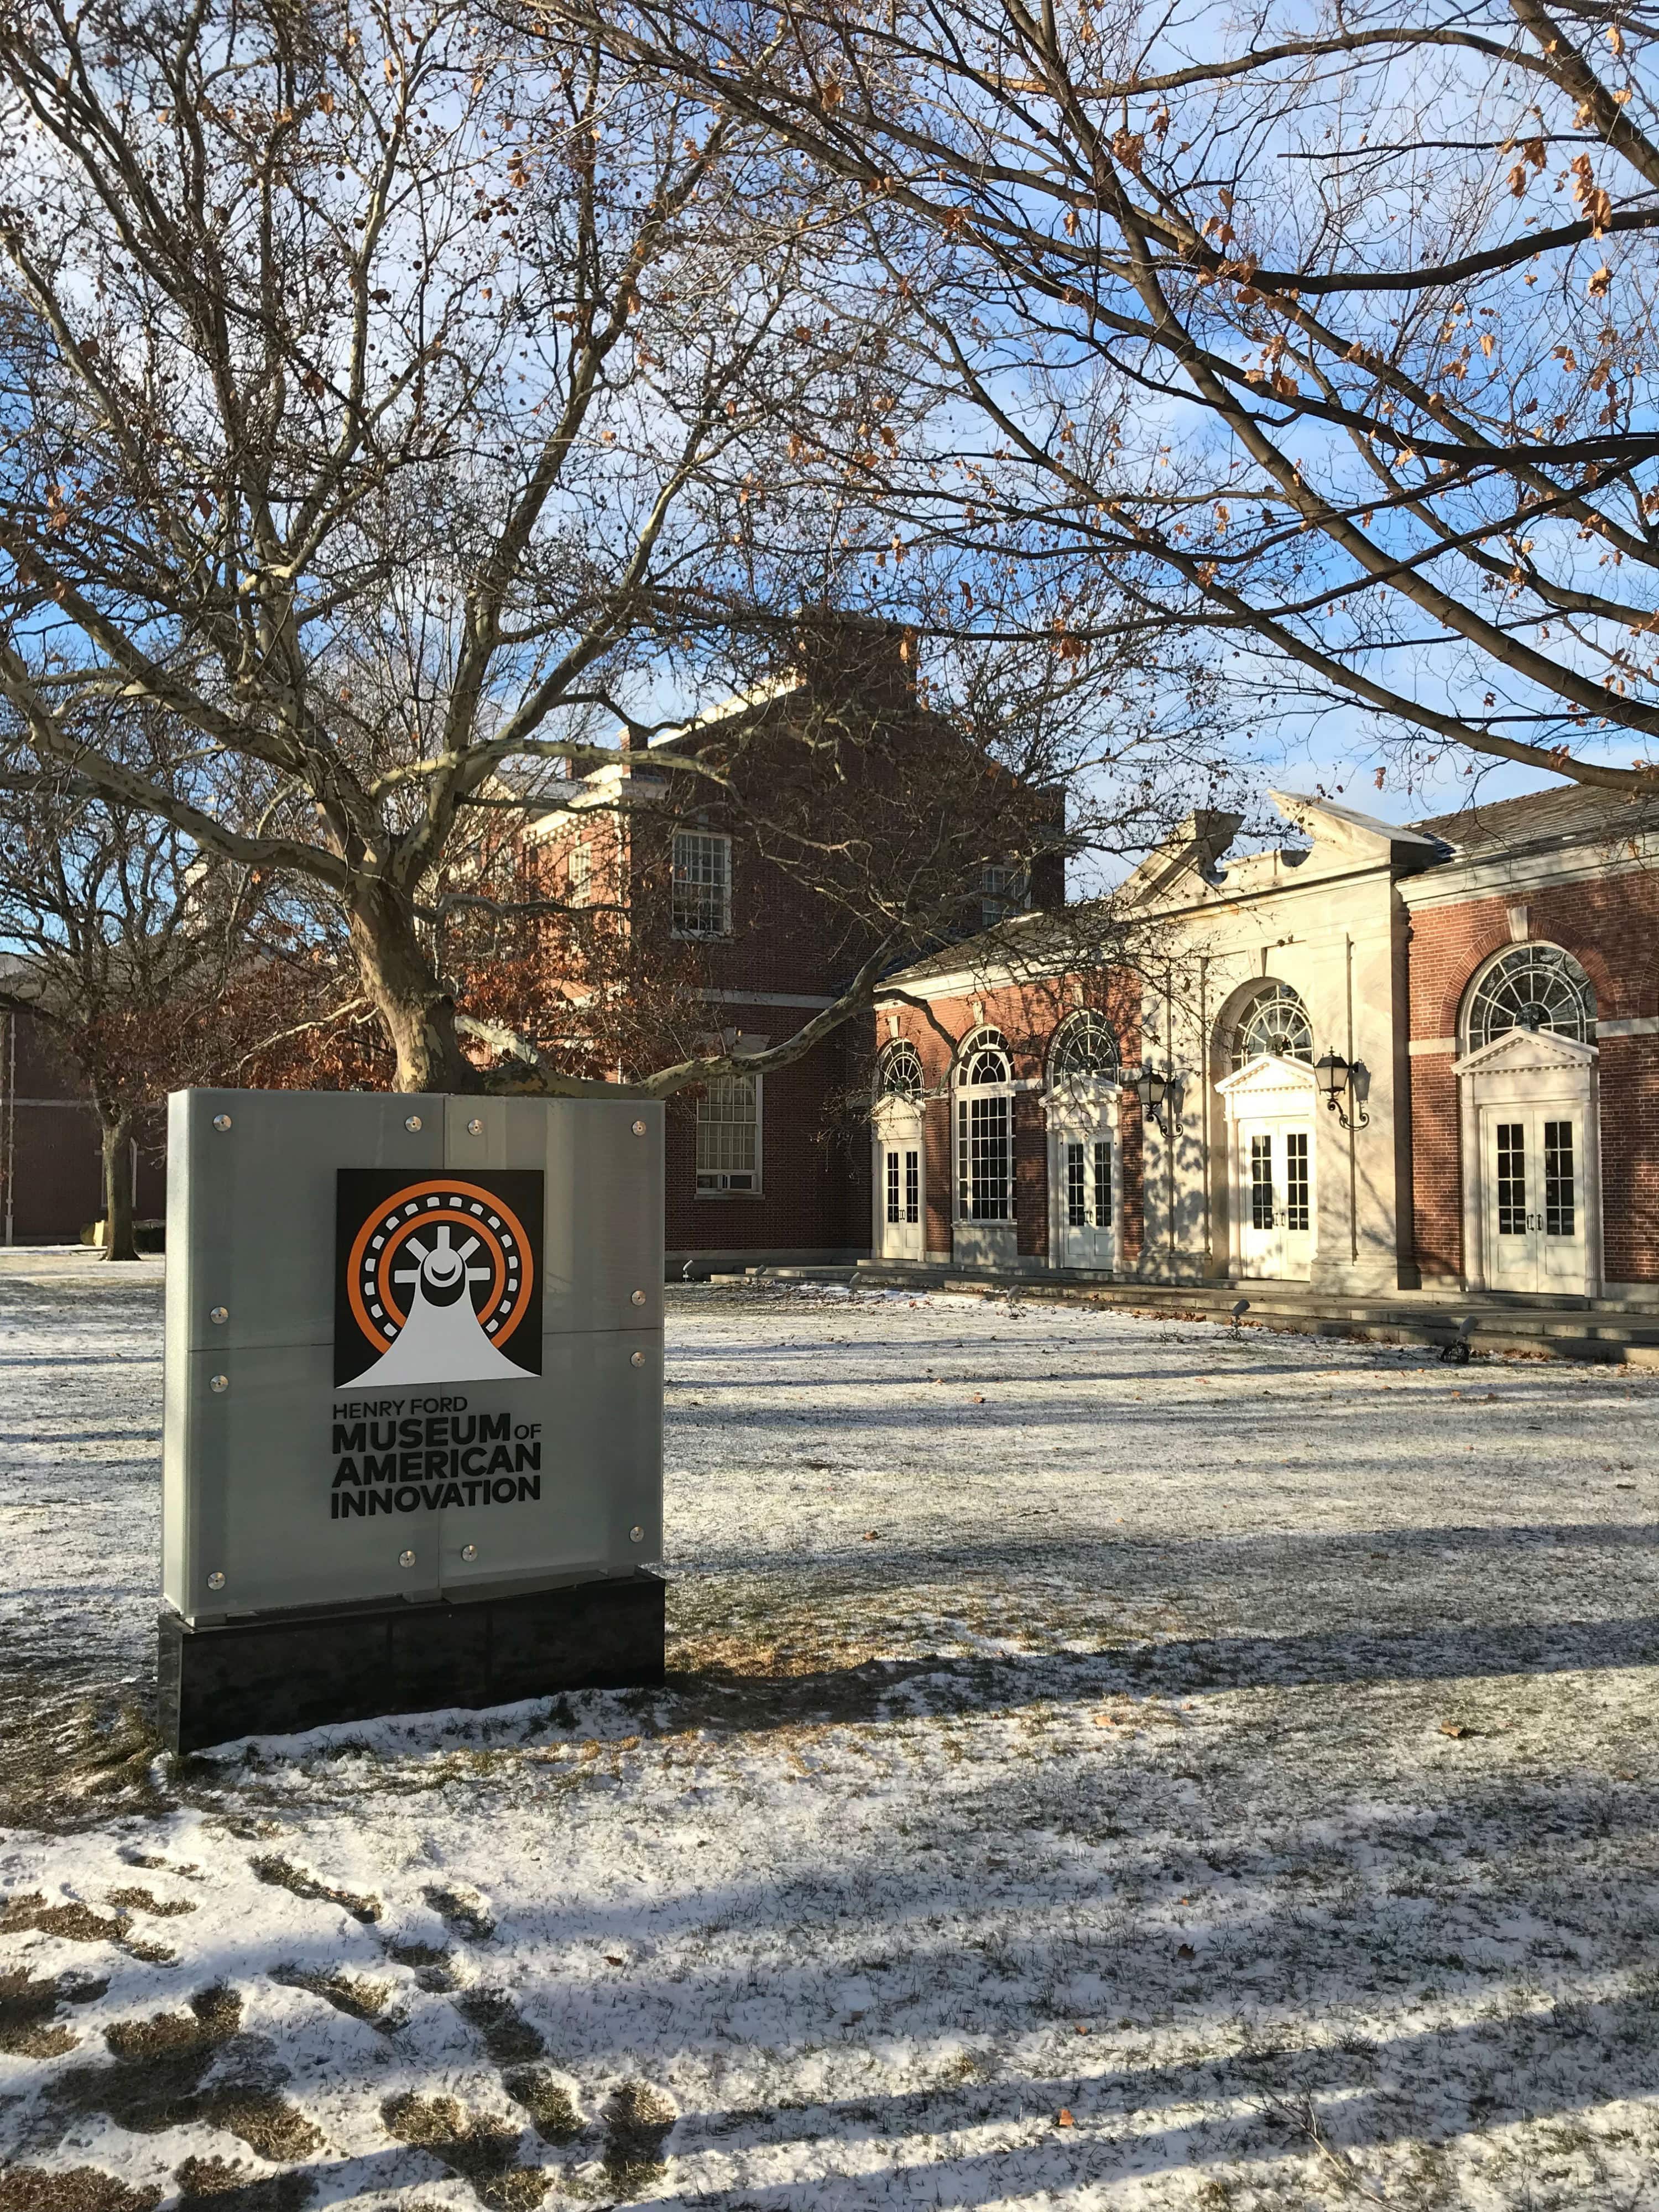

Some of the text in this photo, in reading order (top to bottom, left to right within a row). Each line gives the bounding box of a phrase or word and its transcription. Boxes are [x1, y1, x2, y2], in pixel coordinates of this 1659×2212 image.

[333, 1396, 468, 1420] HENRY FORD
[332, 1413, 542, 1454] MUSEUM OF
[331, 1442, 541, 1488] AMERICAN
[331, 1475, 541, 1519] INNOVATION
